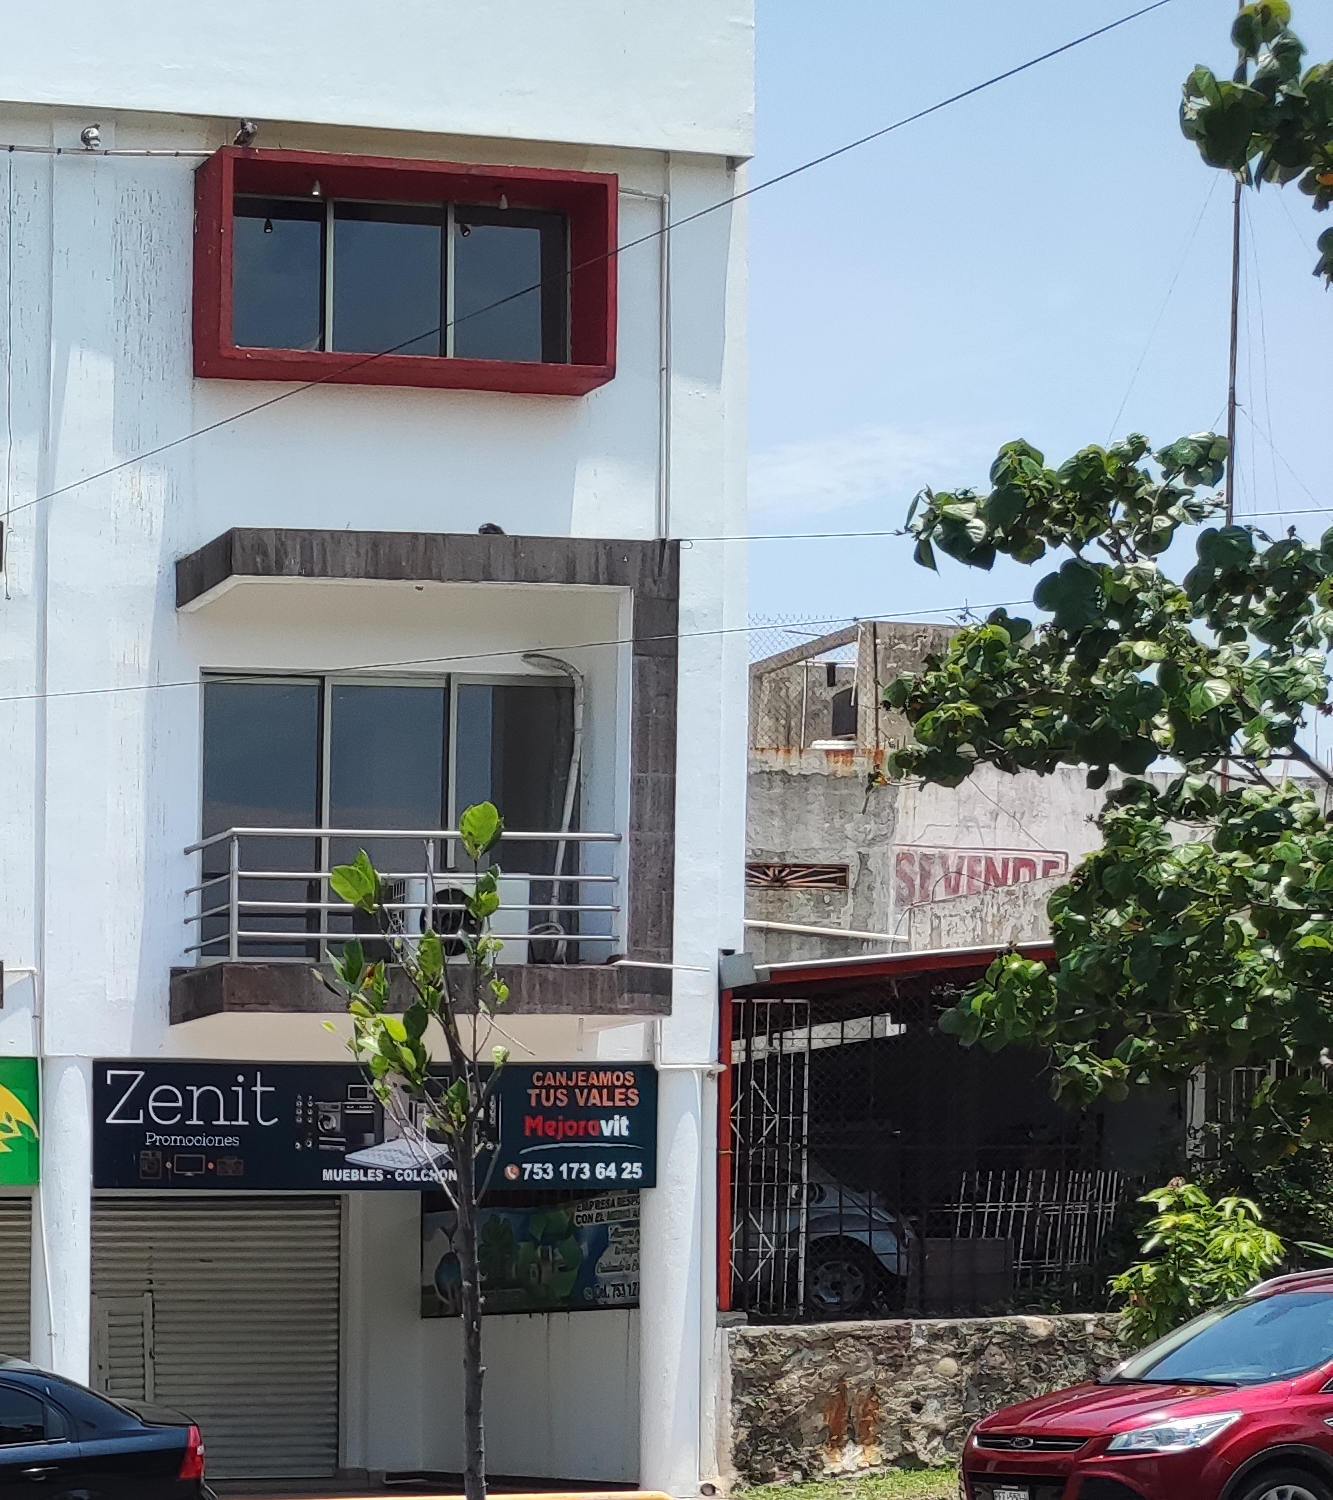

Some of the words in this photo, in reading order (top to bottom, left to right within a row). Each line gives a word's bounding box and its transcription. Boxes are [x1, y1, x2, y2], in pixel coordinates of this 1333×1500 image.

[533, 1071, 635, 1087] CANJEAMOS
[106, 1070, 279, 1126] Zenit
[527, 1088, 568, 1107] TUS
[575, 1088, 640, 1107] VALES
[524, 1115, 630, 1141] Mejoravit
[145, 1132, 240, 1147] Promociones
[322, 1169, 384, 1182] MUEBLES
[395, 1169, 458, 1182] COLCHON
[522, 1162, 554, 1180] 753
[559, 1162, 590, 1180] 173
[595, 1162, 617, 1180] 64
[621, 1162, 643, 1180] 25
[576, 1213, 594, 1225] CON
